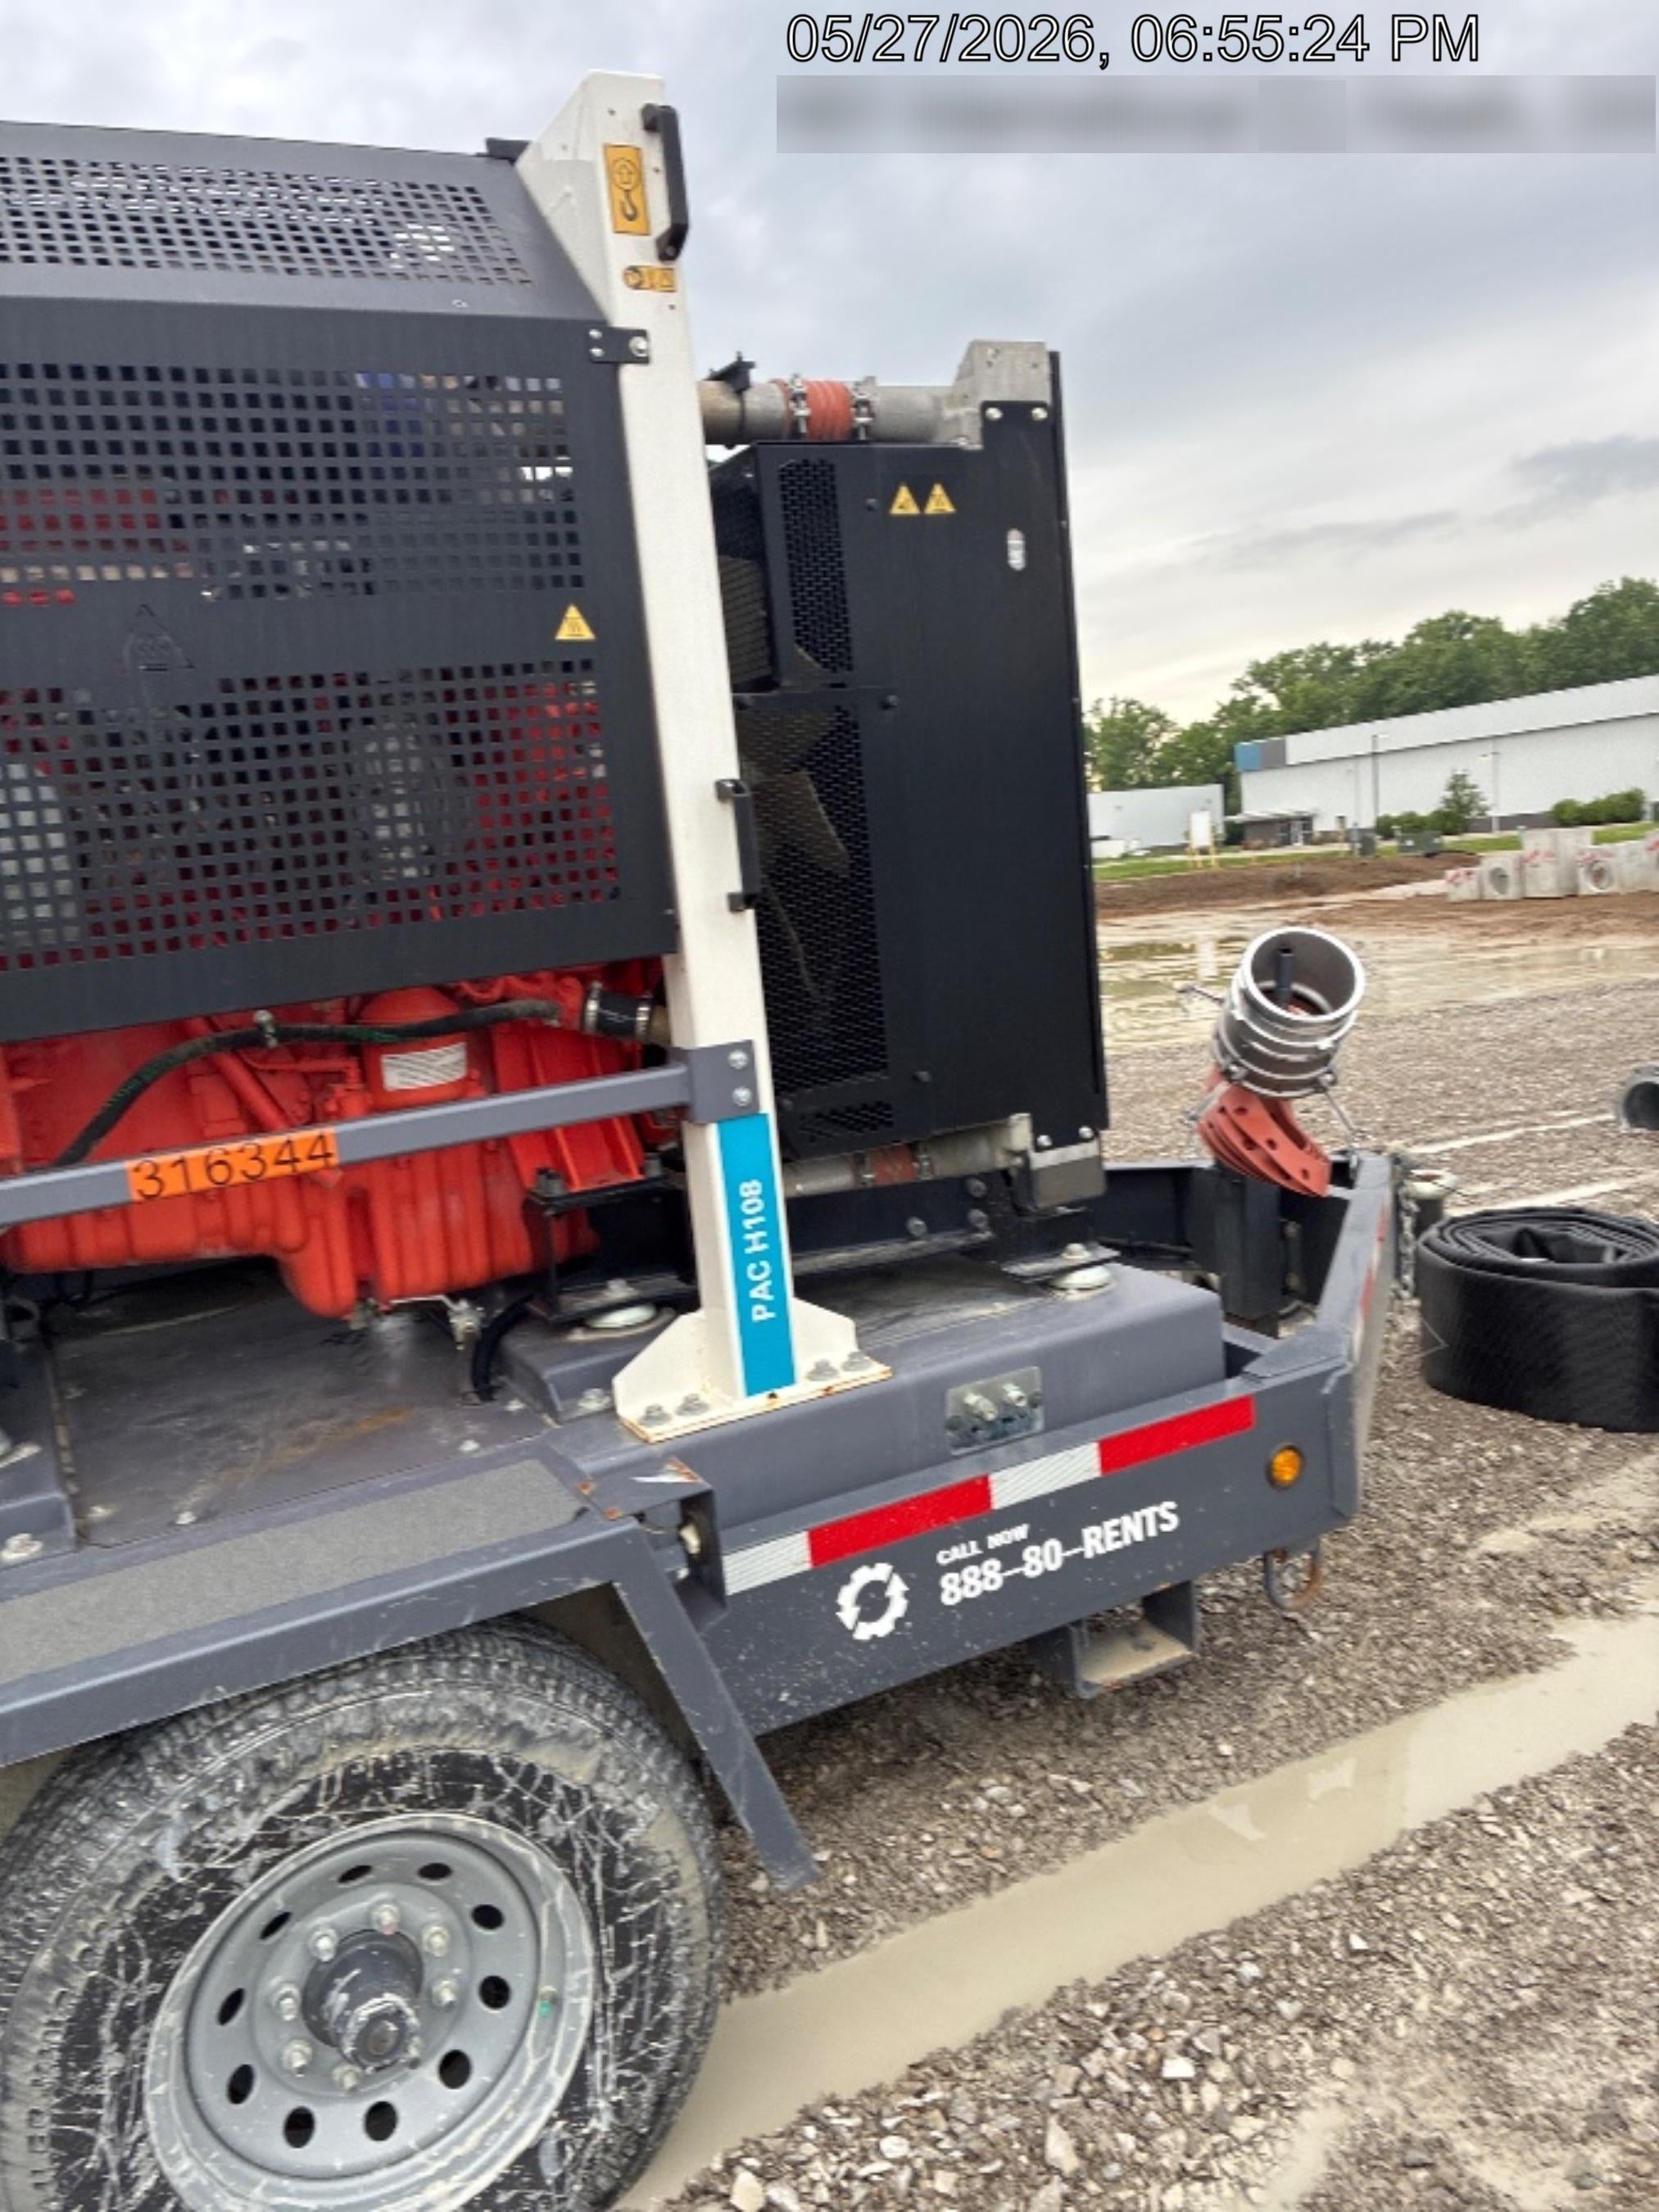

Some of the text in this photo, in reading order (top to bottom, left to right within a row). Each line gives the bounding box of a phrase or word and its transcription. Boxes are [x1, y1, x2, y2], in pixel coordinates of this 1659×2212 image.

[133, 1133, 333, 1200] 316344
[739, 1179, 776, 1322] PAC H108
[936, 1523, 1030, 1566] CALL NOW
[940, 1500, 1180, 1606] 888-80-RENTS
